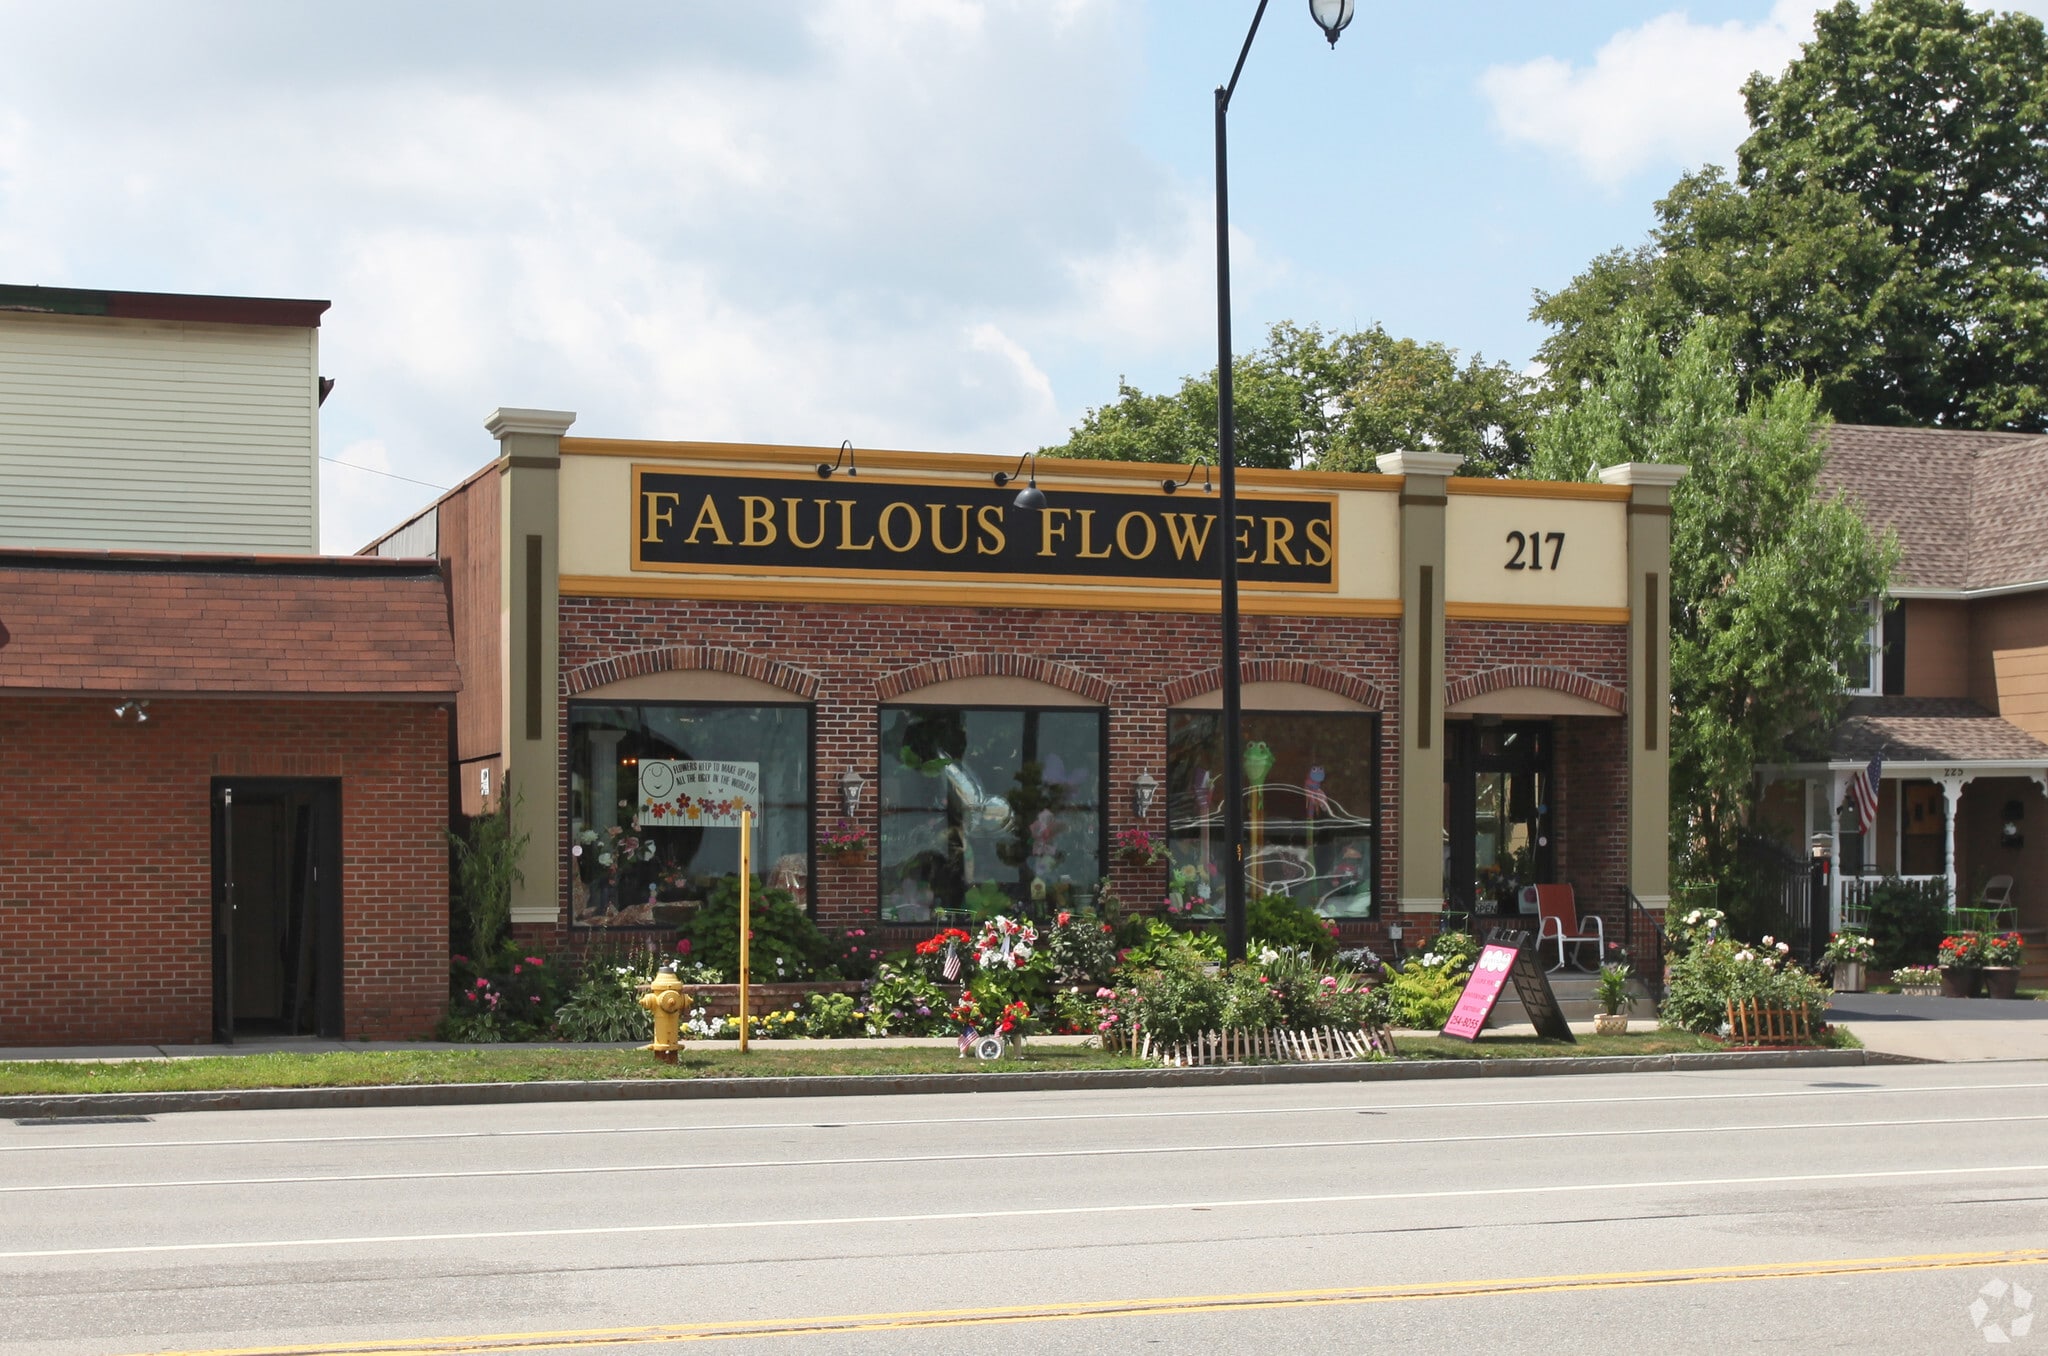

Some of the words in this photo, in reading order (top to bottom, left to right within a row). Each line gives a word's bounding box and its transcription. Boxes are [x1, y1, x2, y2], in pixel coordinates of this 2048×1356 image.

[642, 491, 1006, 556] FABULOUS
[1036, 507, 1332, 567] FLOWERS
[1504, 530, 1565, 570] 217
[673, 762, 697, 774] FLOWERS
[699, 762, 712, 771] HELP
[713, 762, 720, 771] TO
[721, 763, 736, 774] MAKE
[737, 767, 746, 776] UP
[745, 770, 757, 781] FOR
[1944, 768, 1964, 777] 225
[676, 776, 686, 785] ALL
[687, 774, 696, 783] THE
[698, 773, 710, 782] UGLY
[713, 774, 719, 783] IN
[721, 775, 730, 785] THE
[731, 778, 751, 791] WORLD
[1473, 904, 1497, 913] OPEN
[1450, 1015, 1480, 1029] 254-8055
